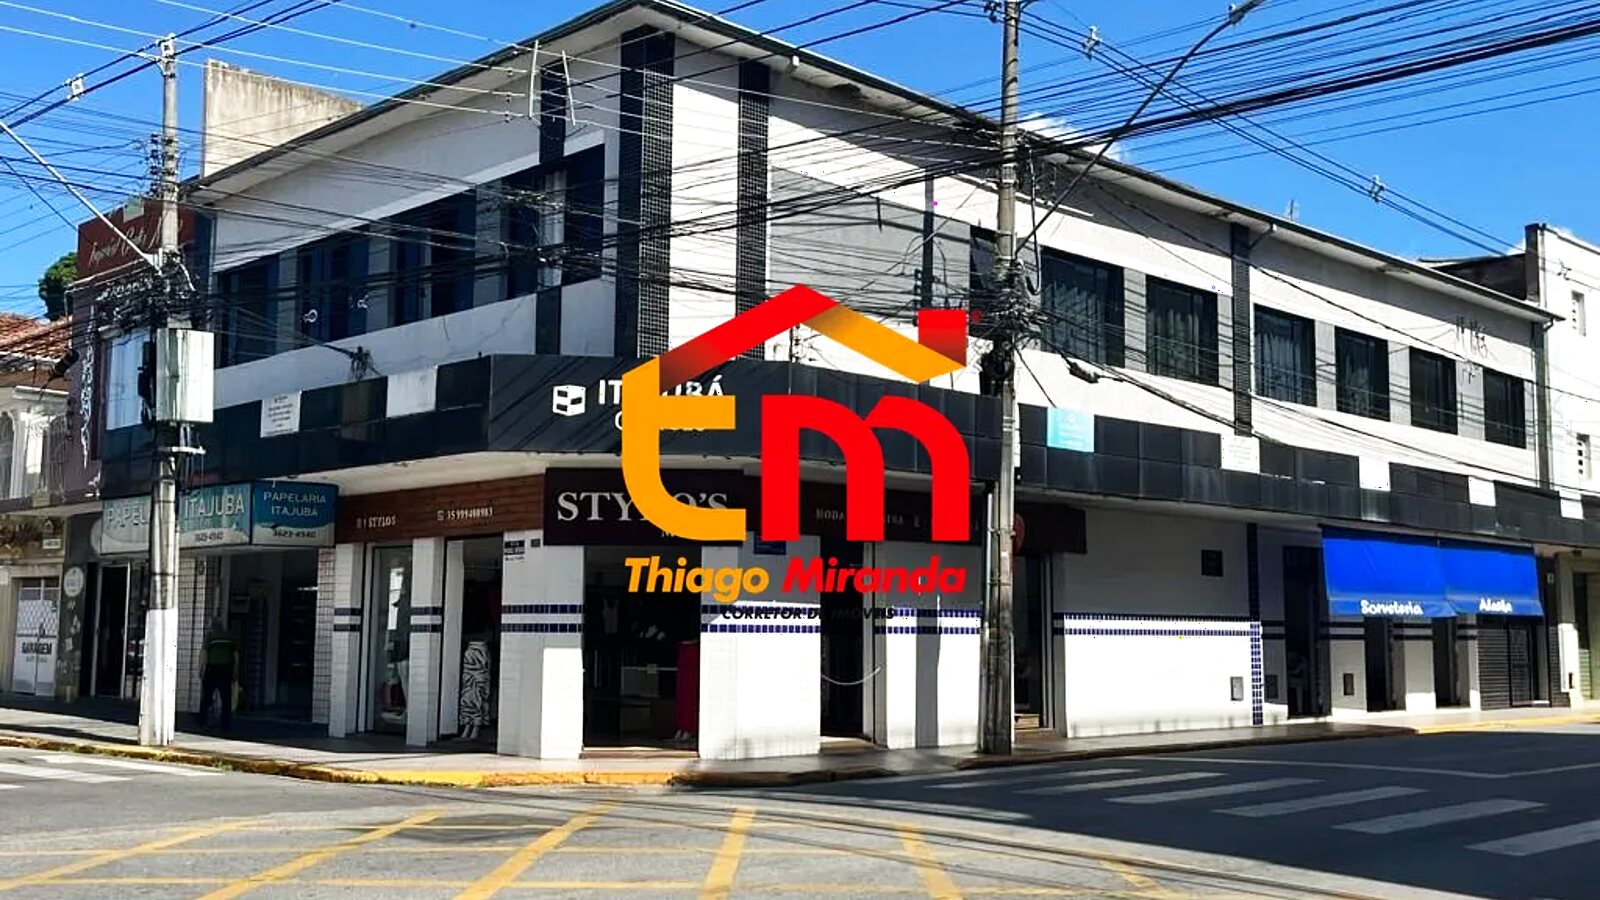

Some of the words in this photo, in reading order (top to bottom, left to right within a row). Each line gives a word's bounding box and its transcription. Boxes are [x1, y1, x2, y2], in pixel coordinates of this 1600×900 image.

[598, 374, 724, 404] ITBÁ
[263, 491, 326, 504] PAPELARIA
[557, 492, 728, 521] STY'S
[271, 506, 318, 518] ITAJUBA
